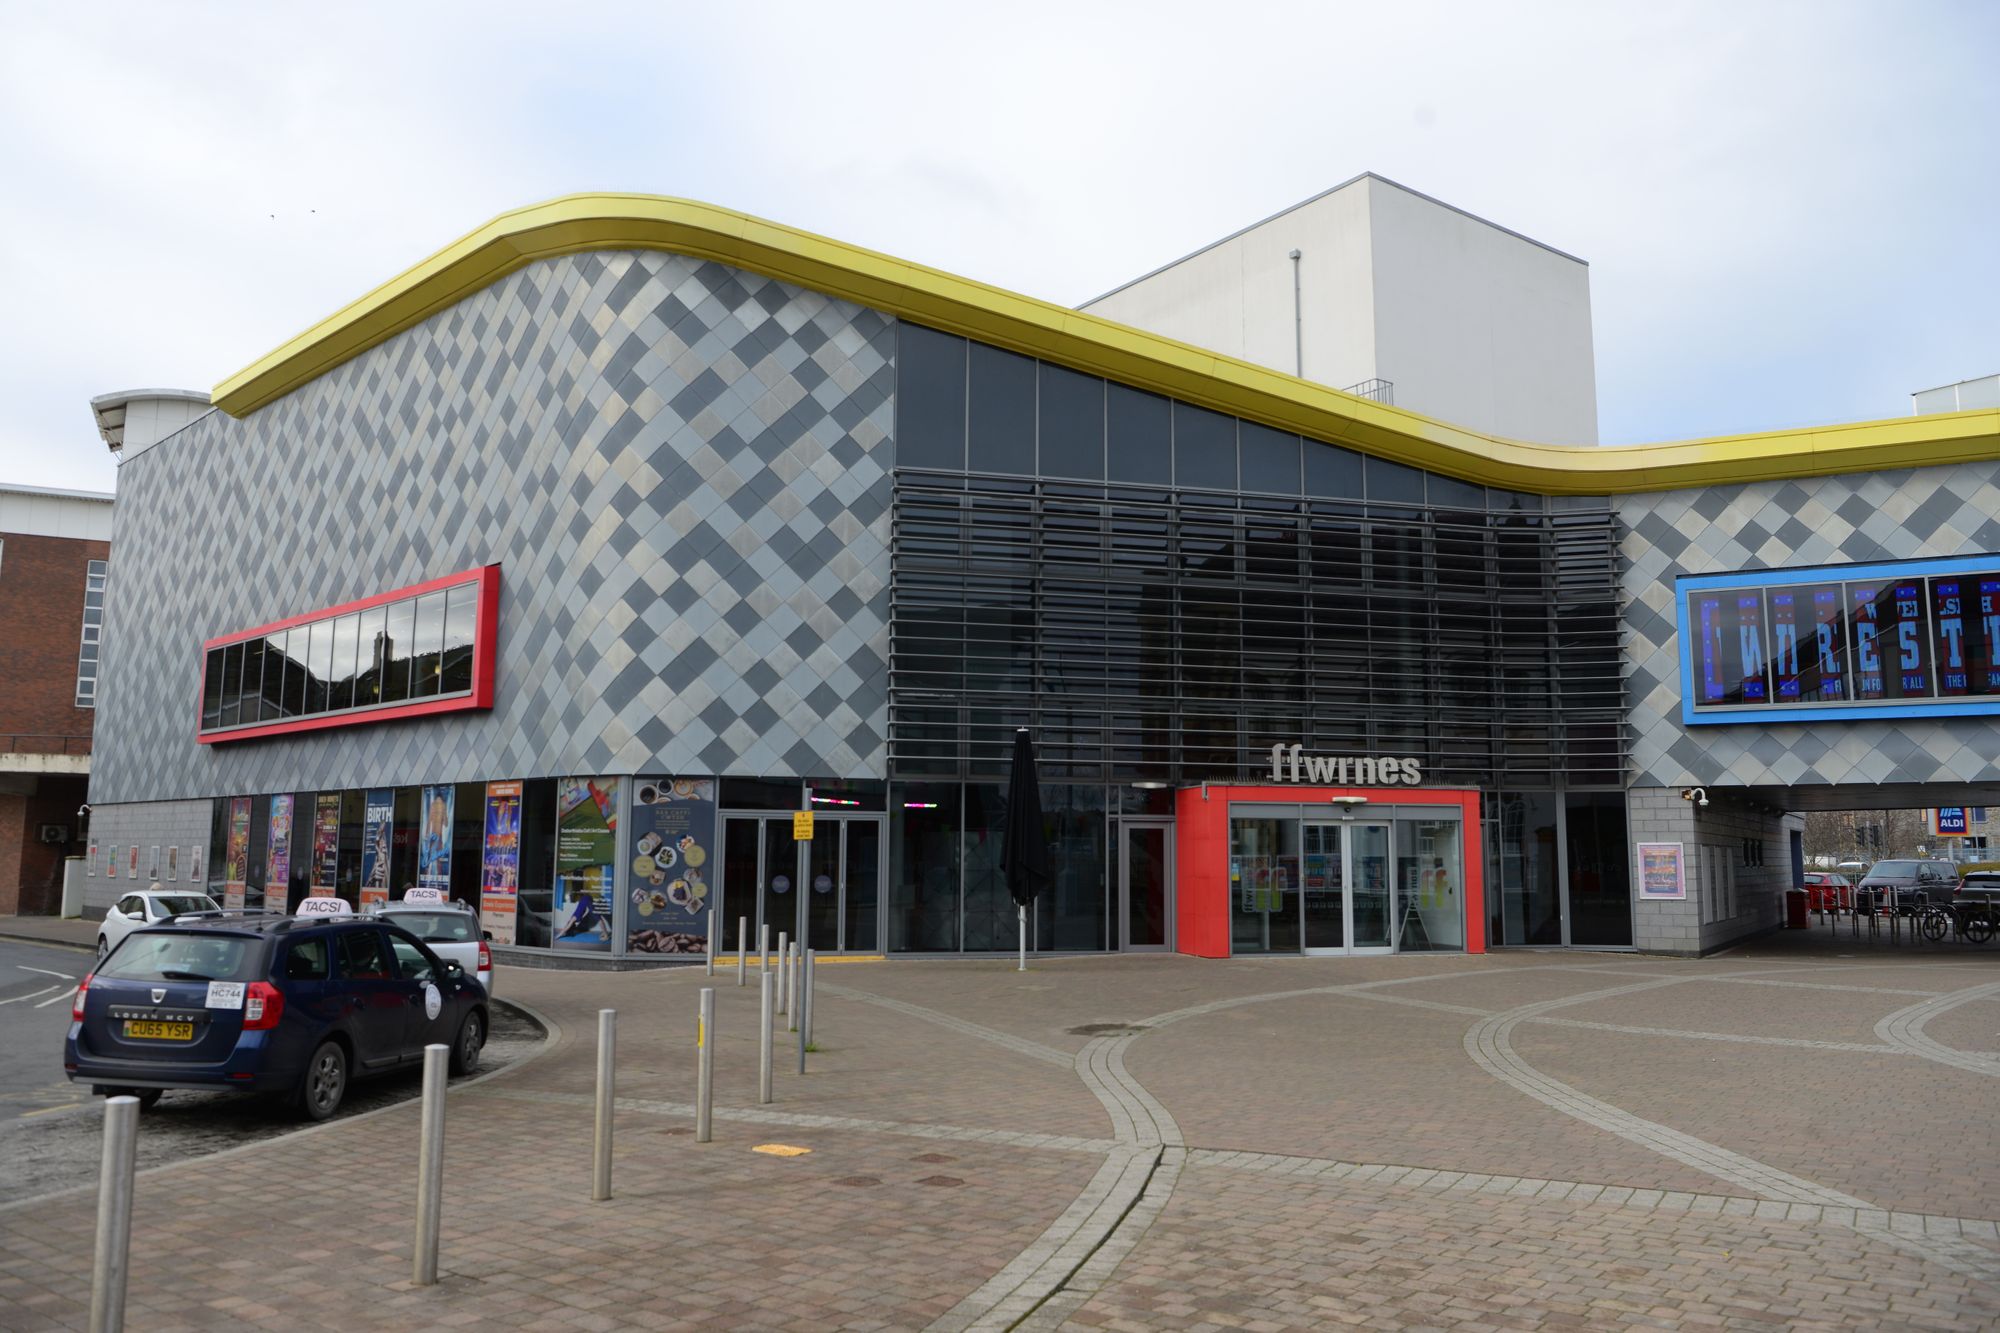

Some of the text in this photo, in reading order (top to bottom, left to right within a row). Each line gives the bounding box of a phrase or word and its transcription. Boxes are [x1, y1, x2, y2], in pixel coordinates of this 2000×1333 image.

[1910, 676, 1924, 689] ALL
[1947, 675, 1963, 688] THE
[1271, 743, 1422, 785] ffwrnes
[367, 806, 392, 823] BIRTH
[1940, 818, 1964, 828] ALDI
[411, 890, 437, 899] TACSI
[305, 901, 342, 913] TACSI
[211, 989, 241, 998] HC744
[114, 1012, 194, 1022] LOGAN MCV
[131, 1022, 191, 1038] CU65 YSR
